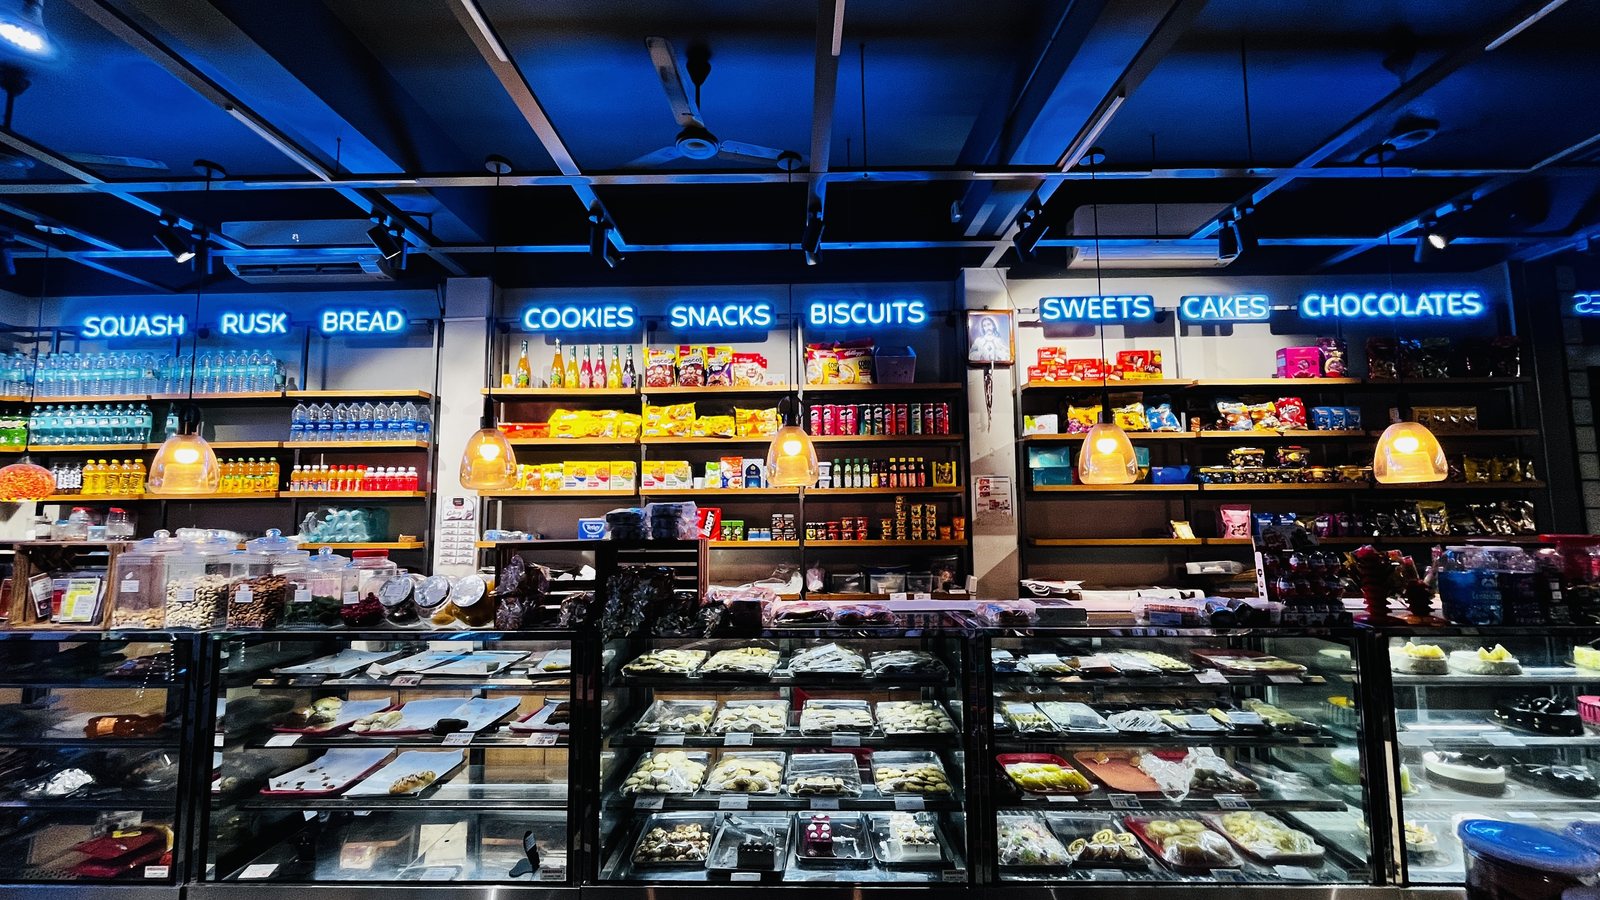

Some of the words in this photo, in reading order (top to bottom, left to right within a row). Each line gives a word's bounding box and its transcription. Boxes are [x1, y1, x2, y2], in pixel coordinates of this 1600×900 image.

[670, 305, 771, 327] SNACKS
[810, 302, 926, 324] BISCUITS
[1042, 296, 1152, 319] SWEETS
[1182, 296, 1268, 319] CAKES
[1302, 293, 1481, 317] CHOCOLATES
[83, 315, 184, 337] SQUASH
[222, 313, 286, 334] RUSK
[322, 311, 403, 333] BREAD
[524, 306, 634, 330] COOKIES
[702, 510, 716, 538] BOOST
